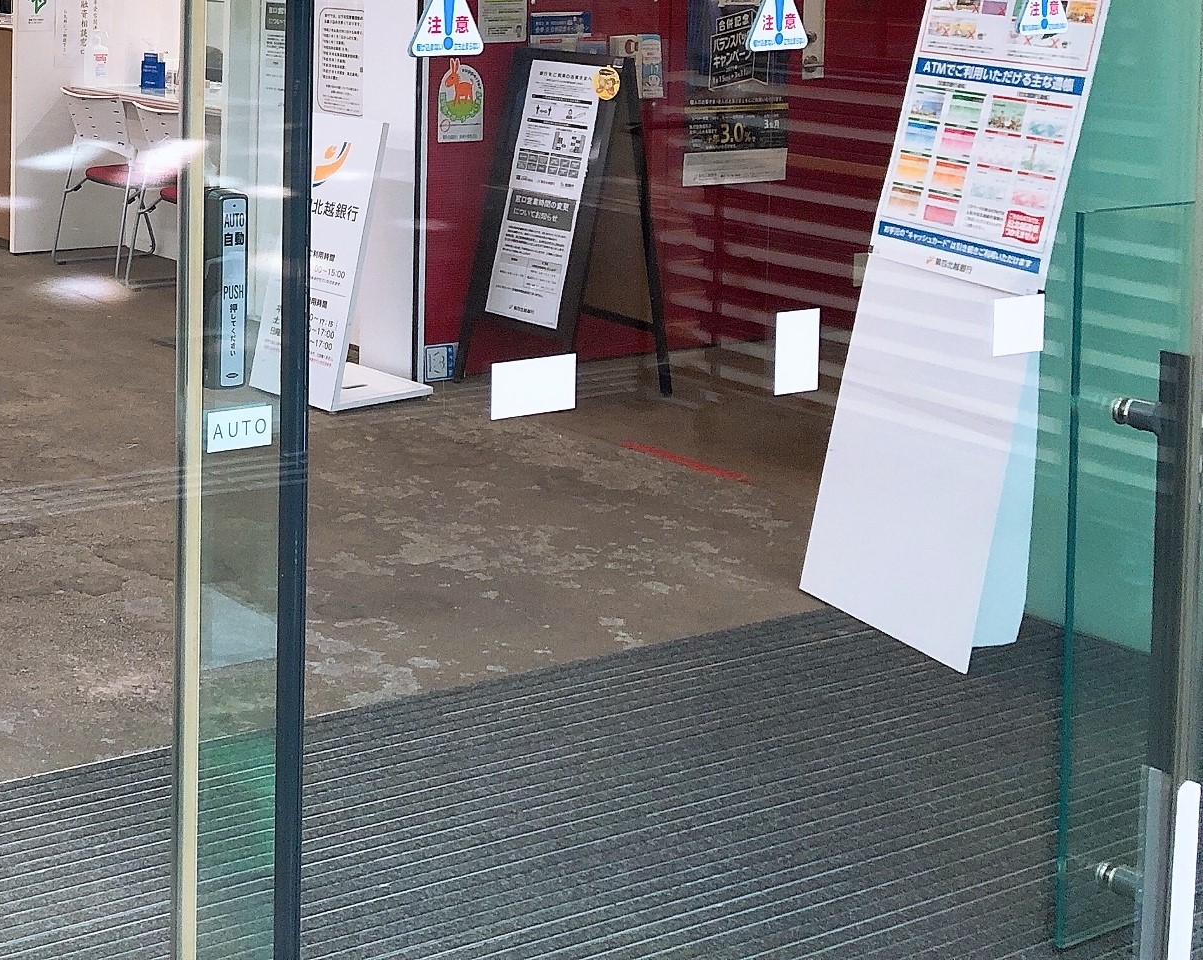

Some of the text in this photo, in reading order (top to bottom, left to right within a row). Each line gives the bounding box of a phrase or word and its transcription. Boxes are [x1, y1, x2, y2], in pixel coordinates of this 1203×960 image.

[428, 15, 469, 34] 注意
[718, 13, 750, 32] 合併記念
[762, 13, 797, 31] 注意
[310, 198, 359, 222] 北越銀行
[515, 194, 569, 212] 窓口営業時間の変更
[224, 212, 245, 229] AUTO
[513, 207, 559, 223] についてお知らせ
[224, 233, 245, 246] 自動
[934, 257, 973, 274] 第四北越銀行
[223, 284, 245, 300] PUSH
[229, 303, 238, 357] 押してください
[213, 418, 267, 441] AUTO
